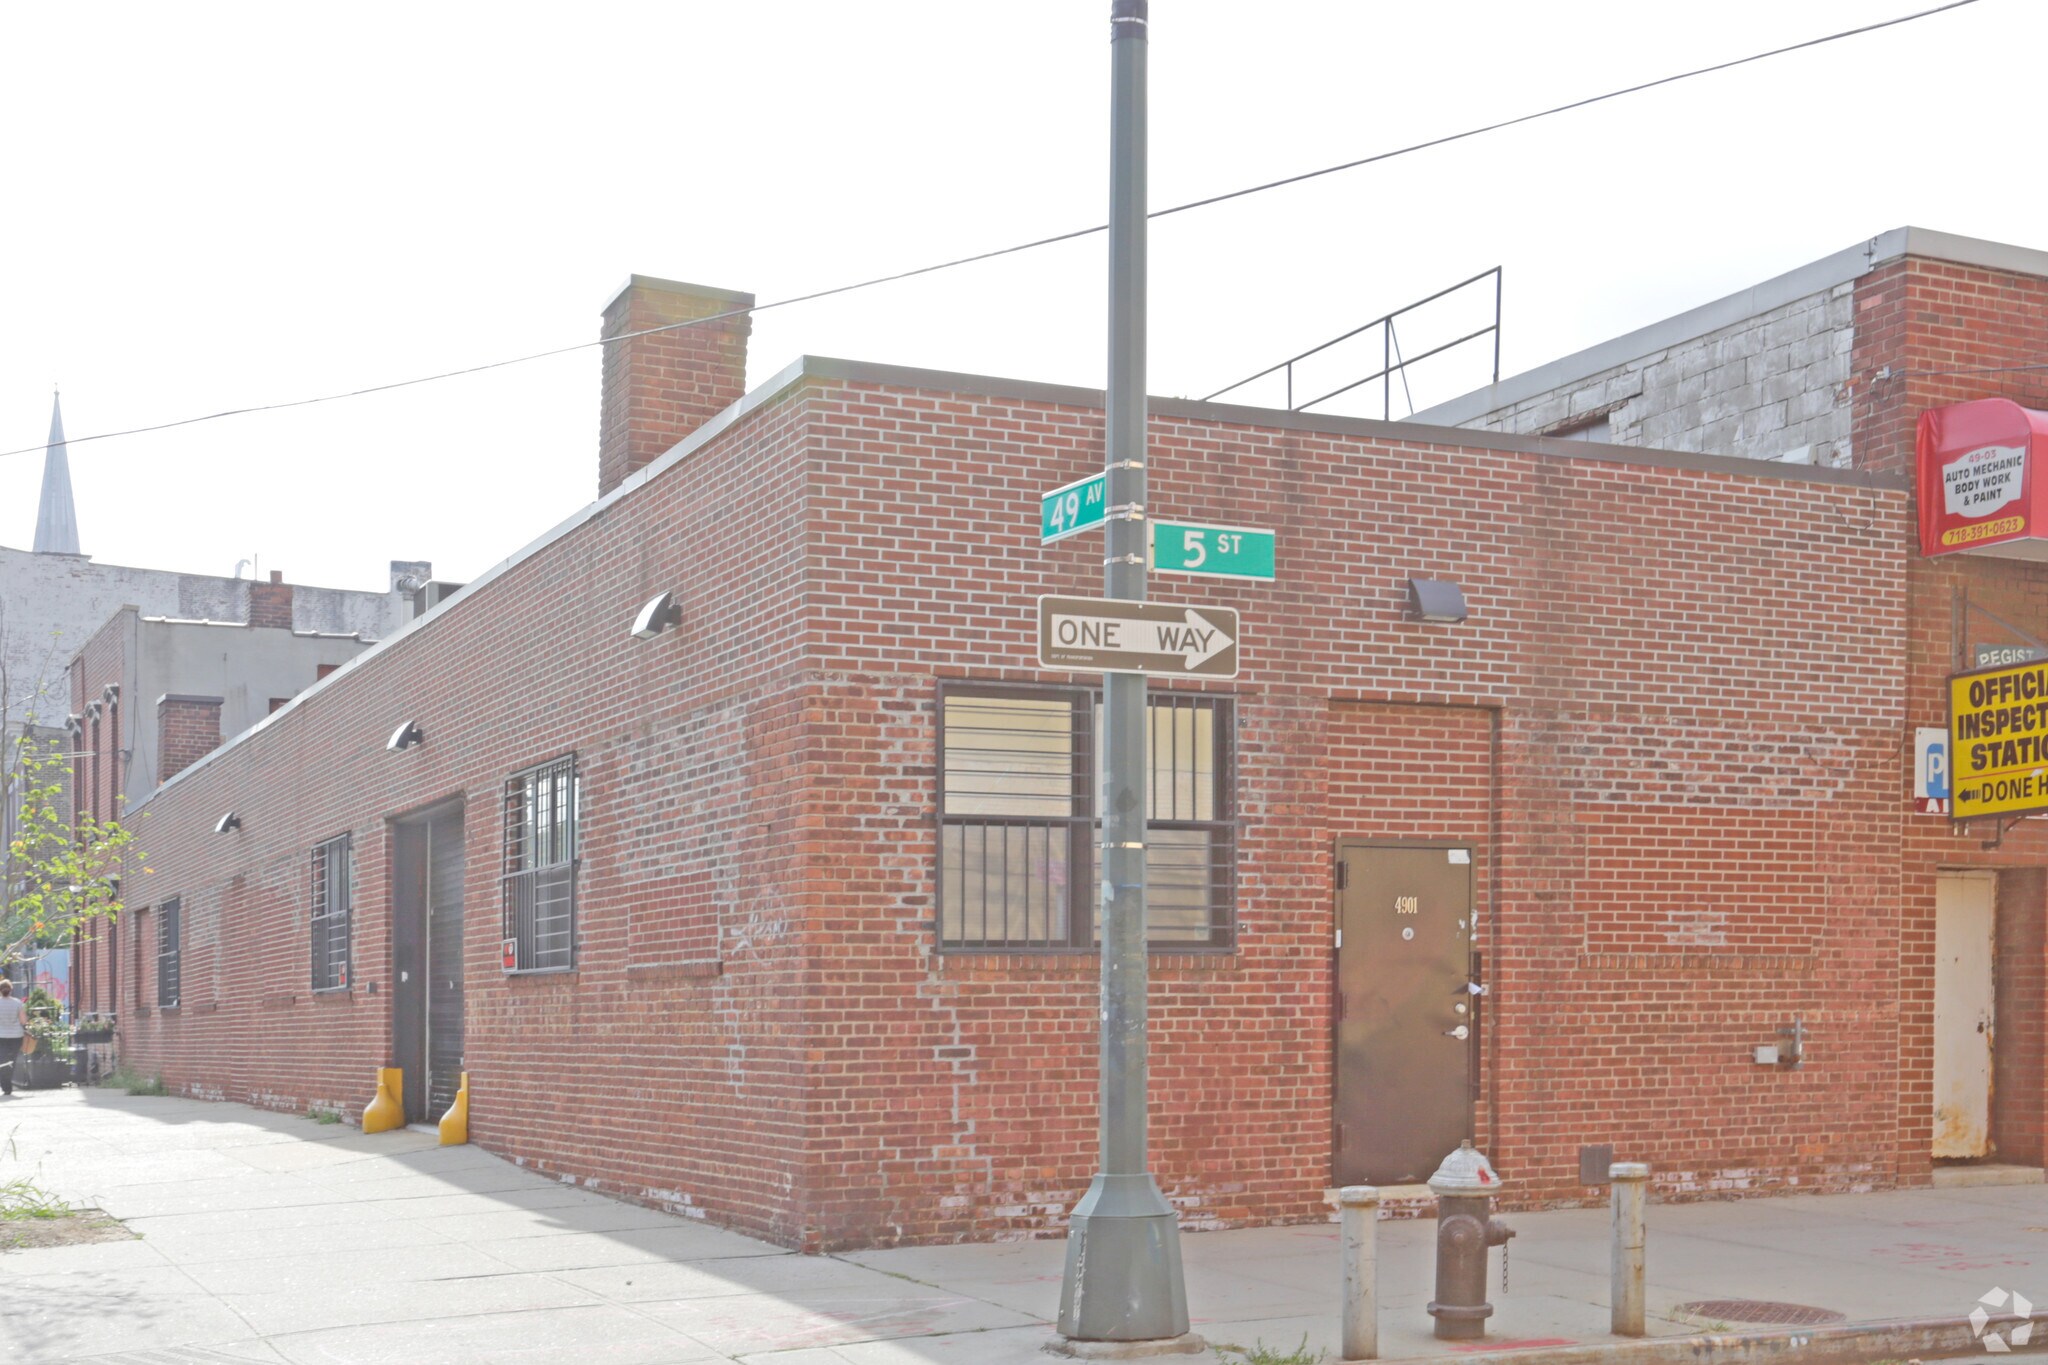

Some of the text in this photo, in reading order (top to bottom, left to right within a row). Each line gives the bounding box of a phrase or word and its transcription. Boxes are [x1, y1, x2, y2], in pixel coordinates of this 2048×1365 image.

[1945, 455, 2023, 483] AUTO MECHANIC
[1968, 449, 1997, 463] 49-03
[1954, 471, 2011, 495] BODY WORK
[1050, 481, 1103, 533] 49 AV
[1963, 488, 2002, 506] & PAINT
[1183, 530, 1242, 568] 5 ST
[1058, 619, 1216, 653] ONE WAY
[1969, 669, 2048, 708] OFFICI
[1982, 777, 2033, 803] DONE
[1394, 896, 1418, 914] 4901
